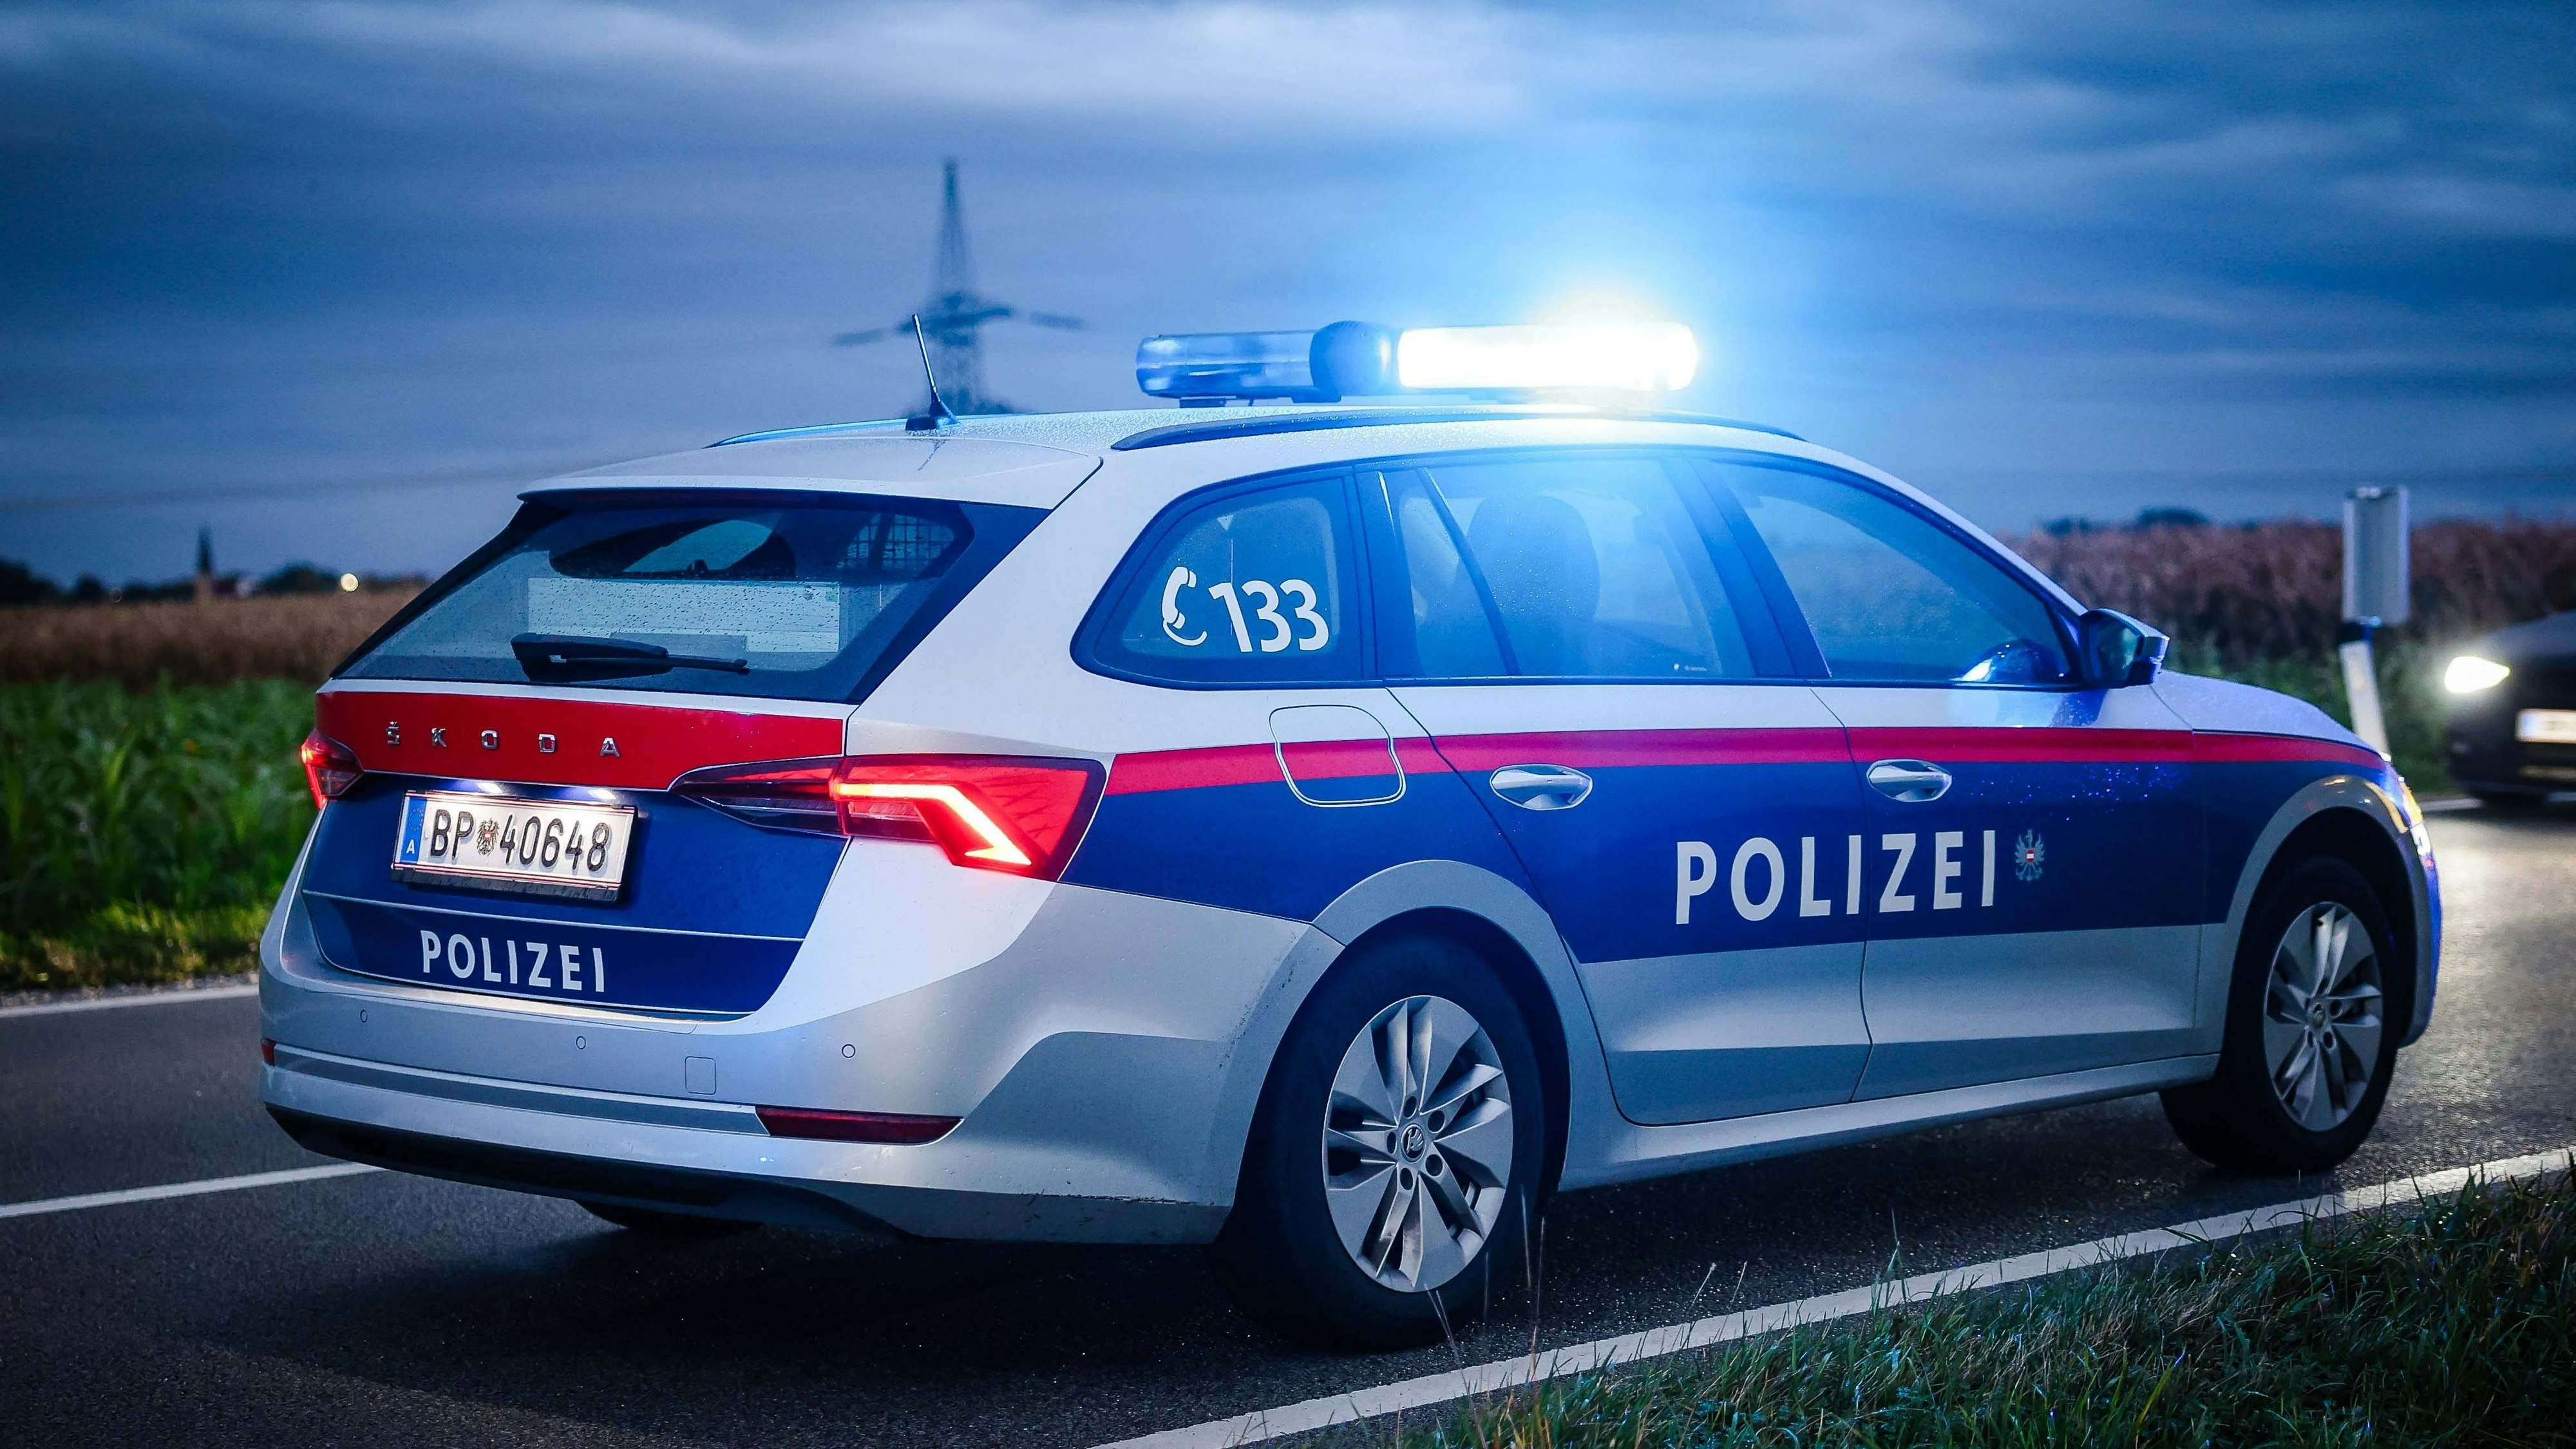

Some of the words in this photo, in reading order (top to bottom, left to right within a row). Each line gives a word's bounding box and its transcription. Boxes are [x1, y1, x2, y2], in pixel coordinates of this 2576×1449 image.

[1208, 579, 1329, 652] 133
[387, 721, 620, 757] ŠKODA
[406, 839, 415, 855] A
[431, 809, 474, 858] BP
[500, 813, 611, 872] 40648
[1676, 830, 1995, 924] POLIZEI
[421, 930, 604, 992] POLIZEI
